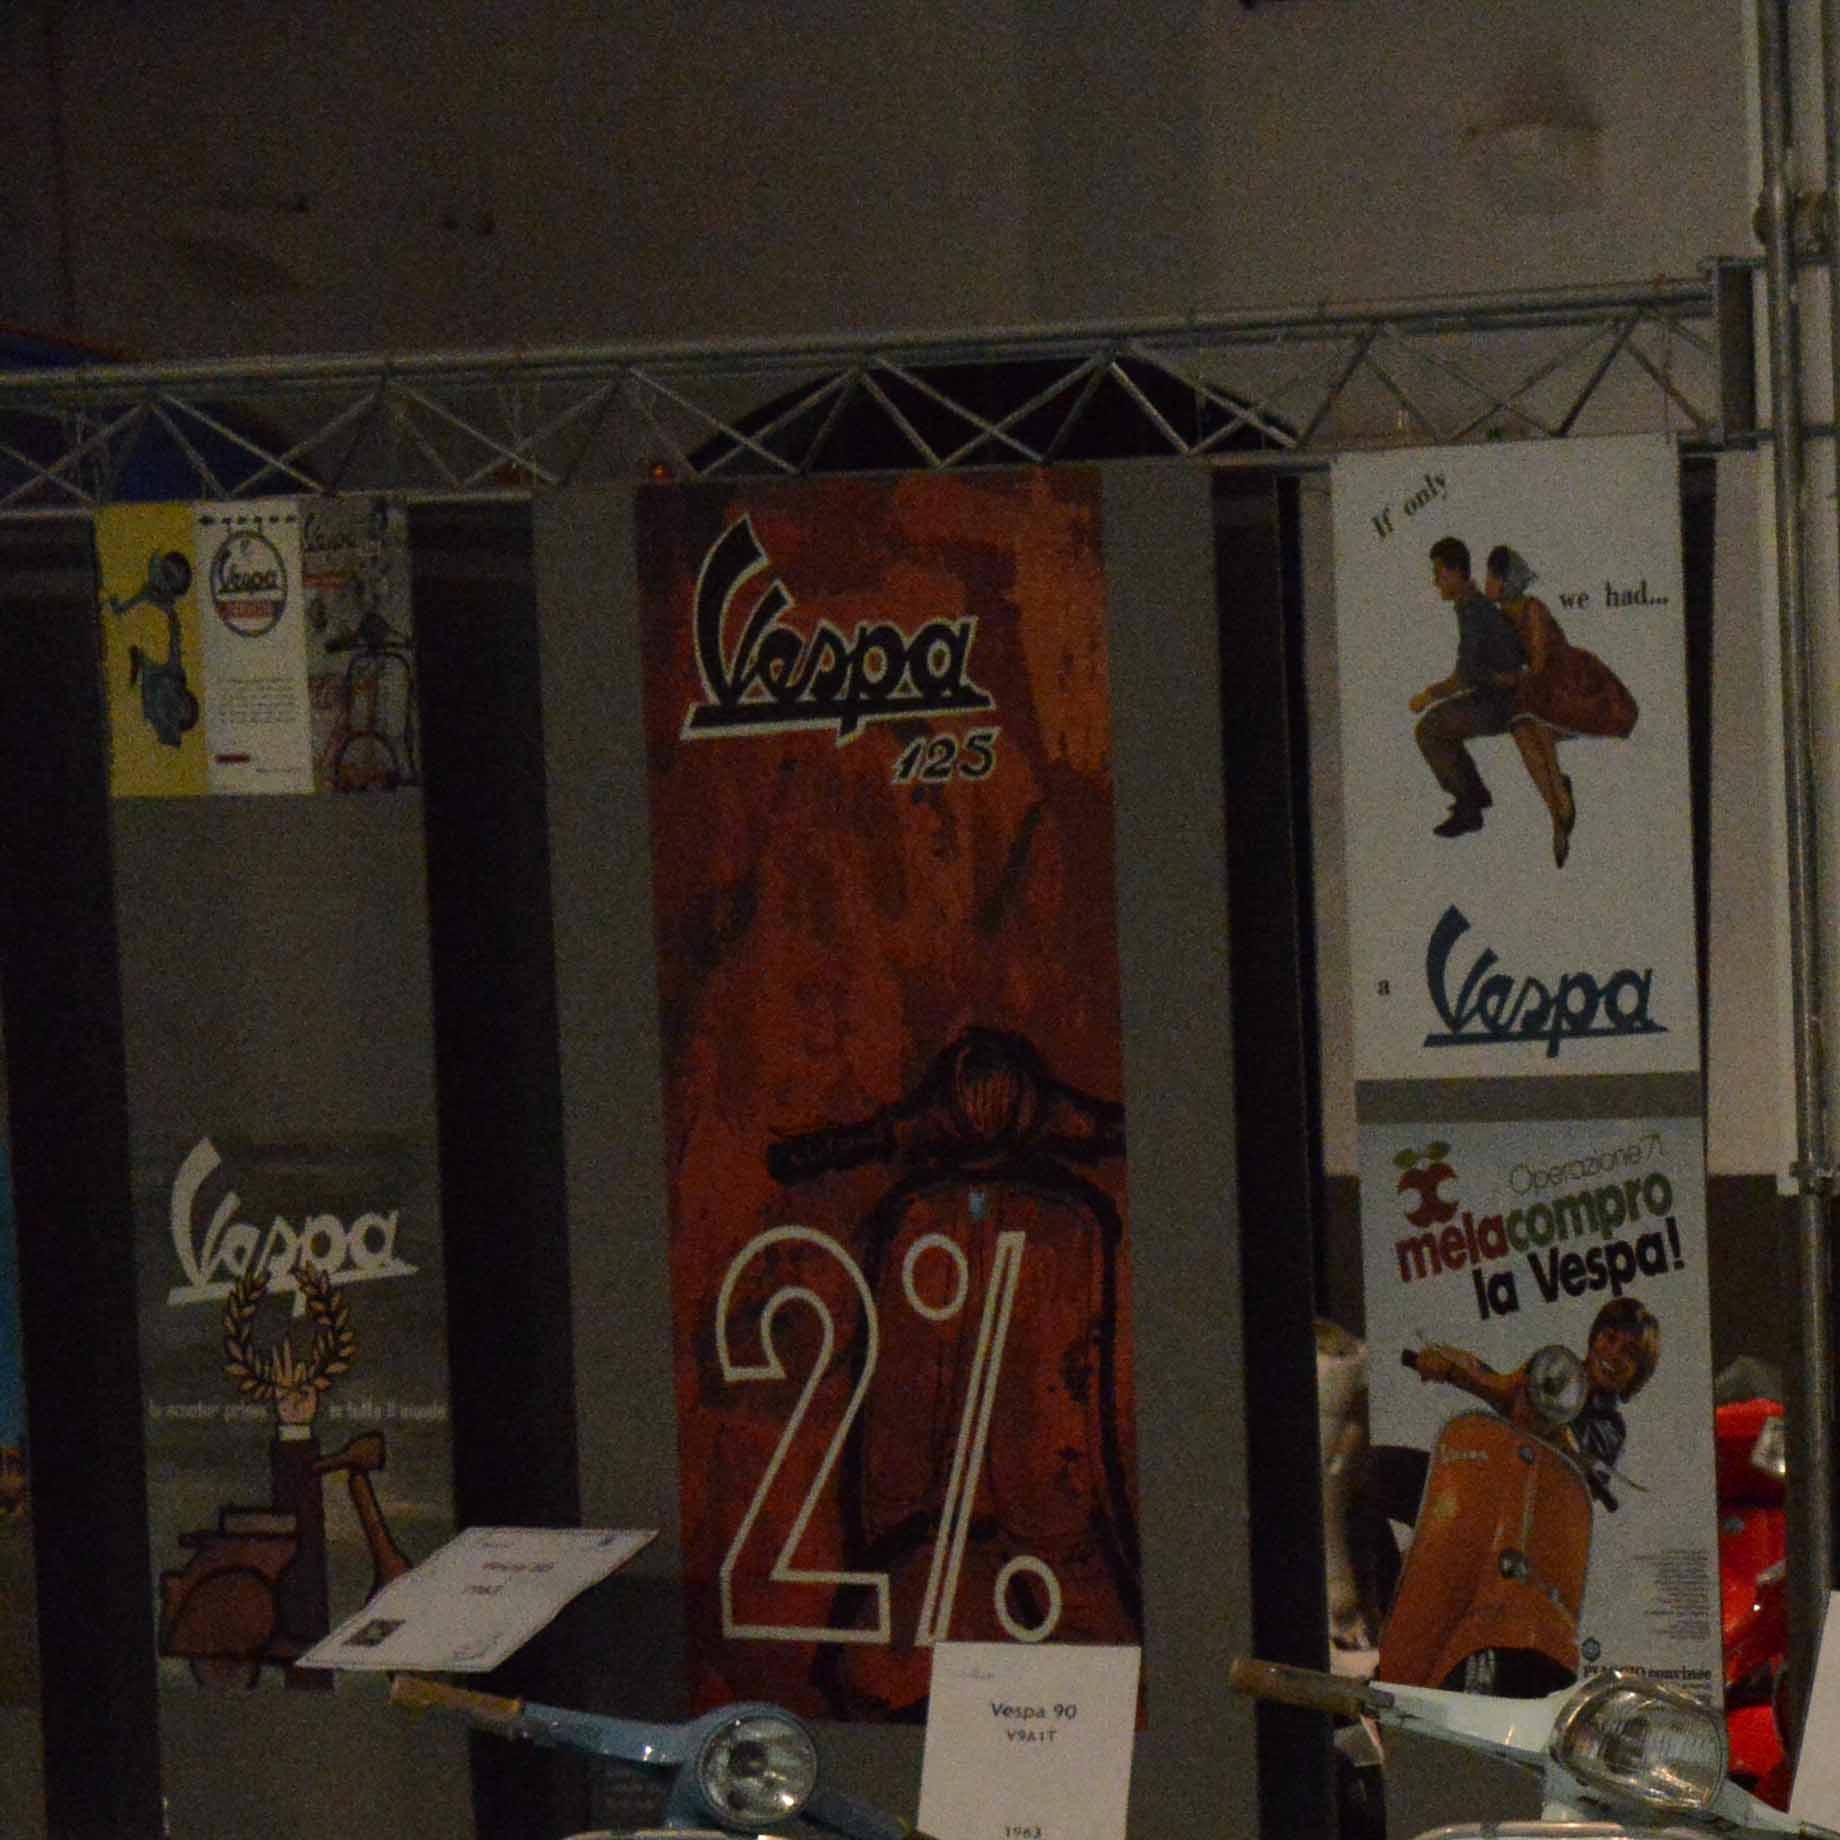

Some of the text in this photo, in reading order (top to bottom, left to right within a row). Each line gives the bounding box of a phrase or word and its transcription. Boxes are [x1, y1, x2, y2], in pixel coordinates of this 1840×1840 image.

[1370, 467, 1446, 540] If only
[680, 512, 996, 748] Vespa
[1559, 594, 1590, 610] we
[892, 726, 1000, 785] 125
[1378, 904, 1668, 1058] a Vespa
[166, 1136, 420, 1318] Vespa
[1473, 1216, 1685, 1320] la Vespa!
[991, 1703, 1078, 1720] Vespa 90
